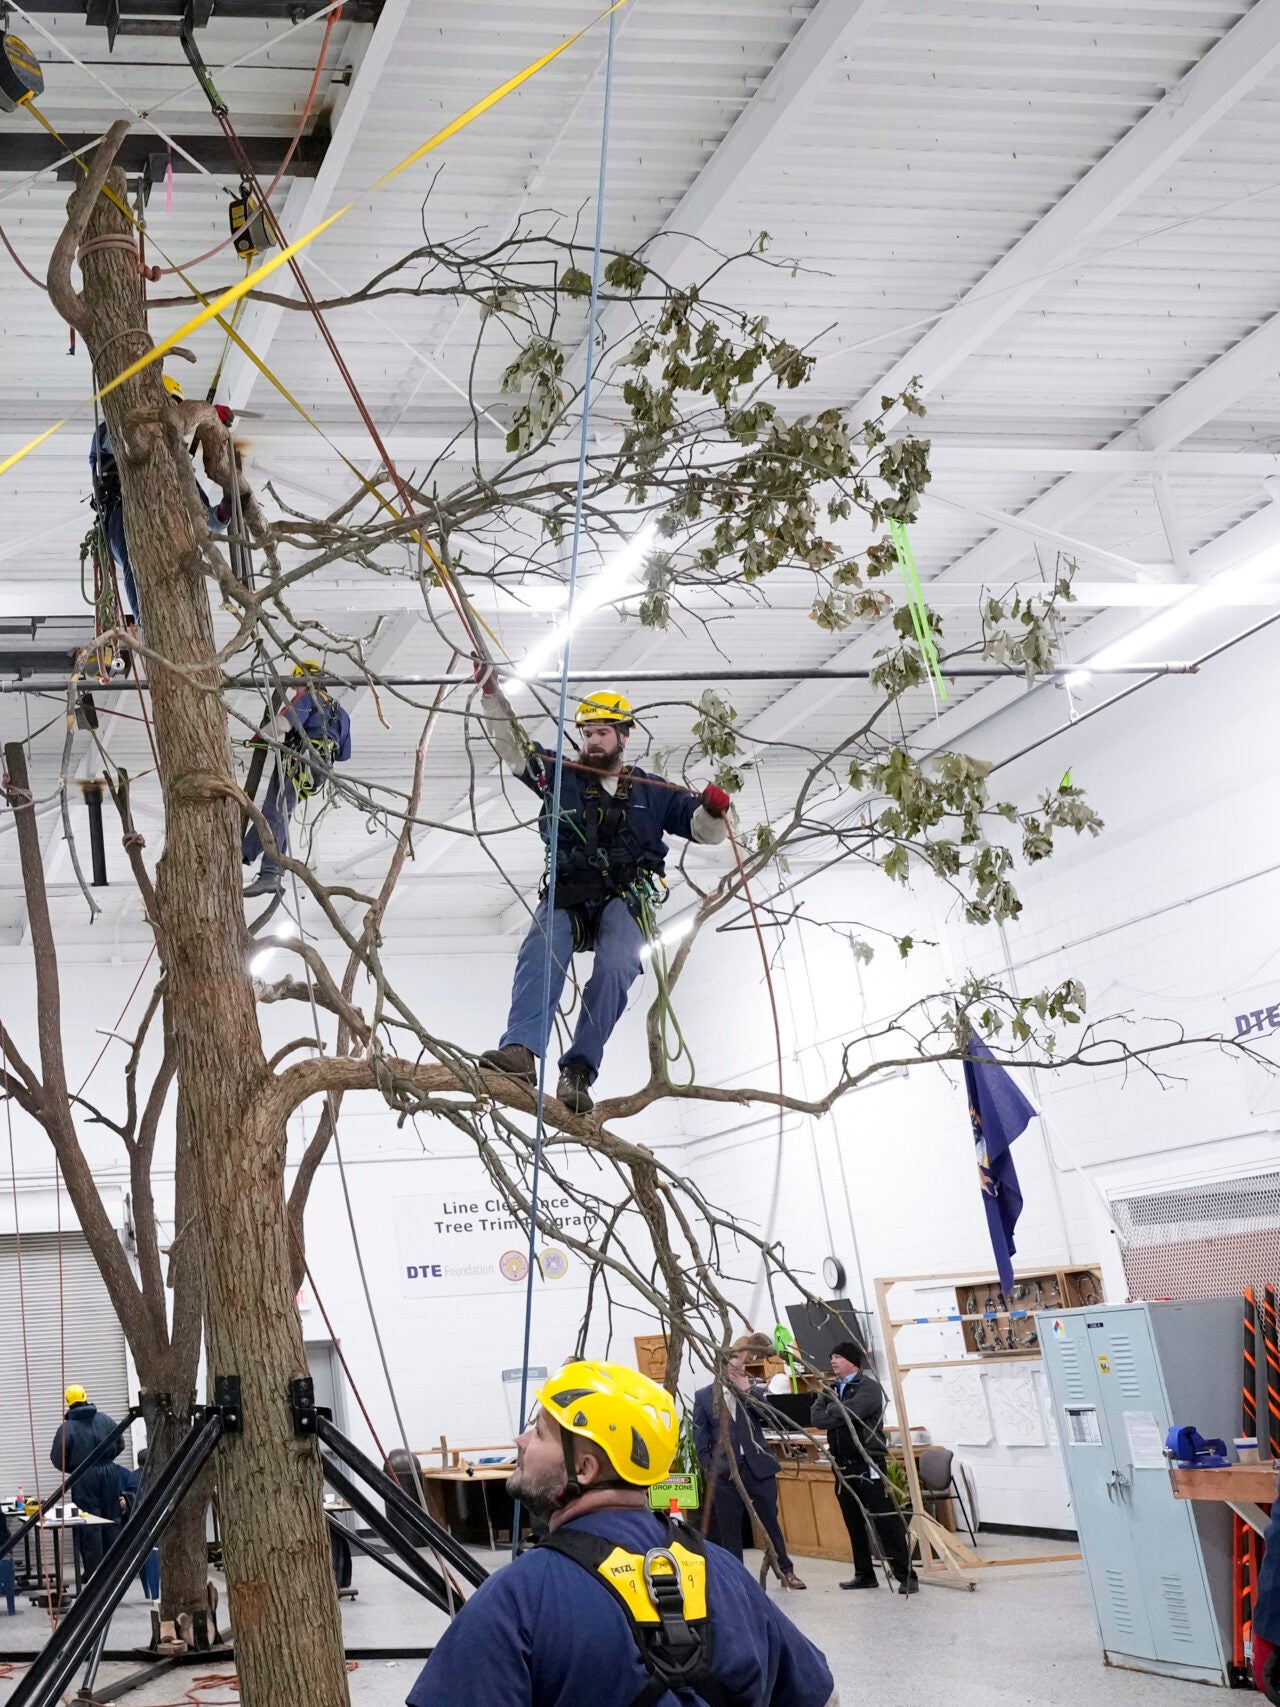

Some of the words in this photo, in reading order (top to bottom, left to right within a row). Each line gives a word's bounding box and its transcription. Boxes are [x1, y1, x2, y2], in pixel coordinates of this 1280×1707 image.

[1234, 1004, 1280, 1037] DTE
[443, 1202, 479, 1215] Line
[434, 1221, 473, 1234] Tree
[478, 1217, 518, 1232] Trim
[406, 1264, 443, 1279] DTE
[444, 1264, 495, 1278] Foundation
